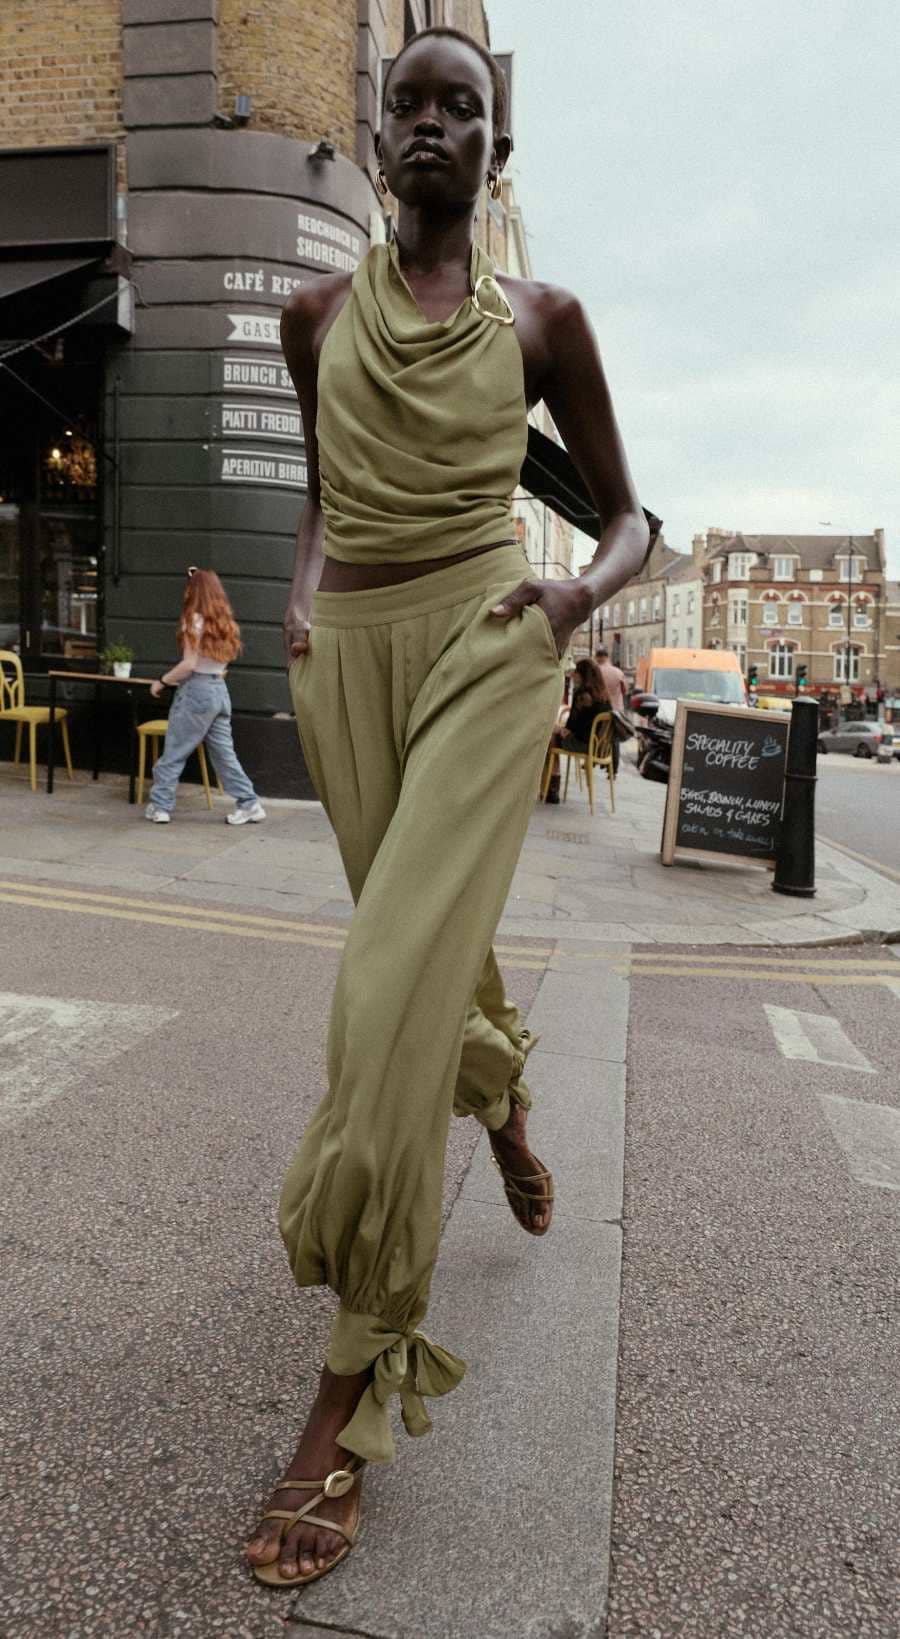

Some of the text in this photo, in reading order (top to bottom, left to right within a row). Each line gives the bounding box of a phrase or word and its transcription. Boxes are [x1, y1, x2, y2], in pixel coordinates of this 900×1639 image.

[223, 269, 264, 292] CAFÉ
[223, 364, 277, 385] BRUNCH
[222, 410, 300, 434] PIATTI FREDDI
[221, 458, 276, 477] APERITIVI
[686, 733, 755, 755] SPECIALITY
[705, 751, 761, 770] COFFEE
